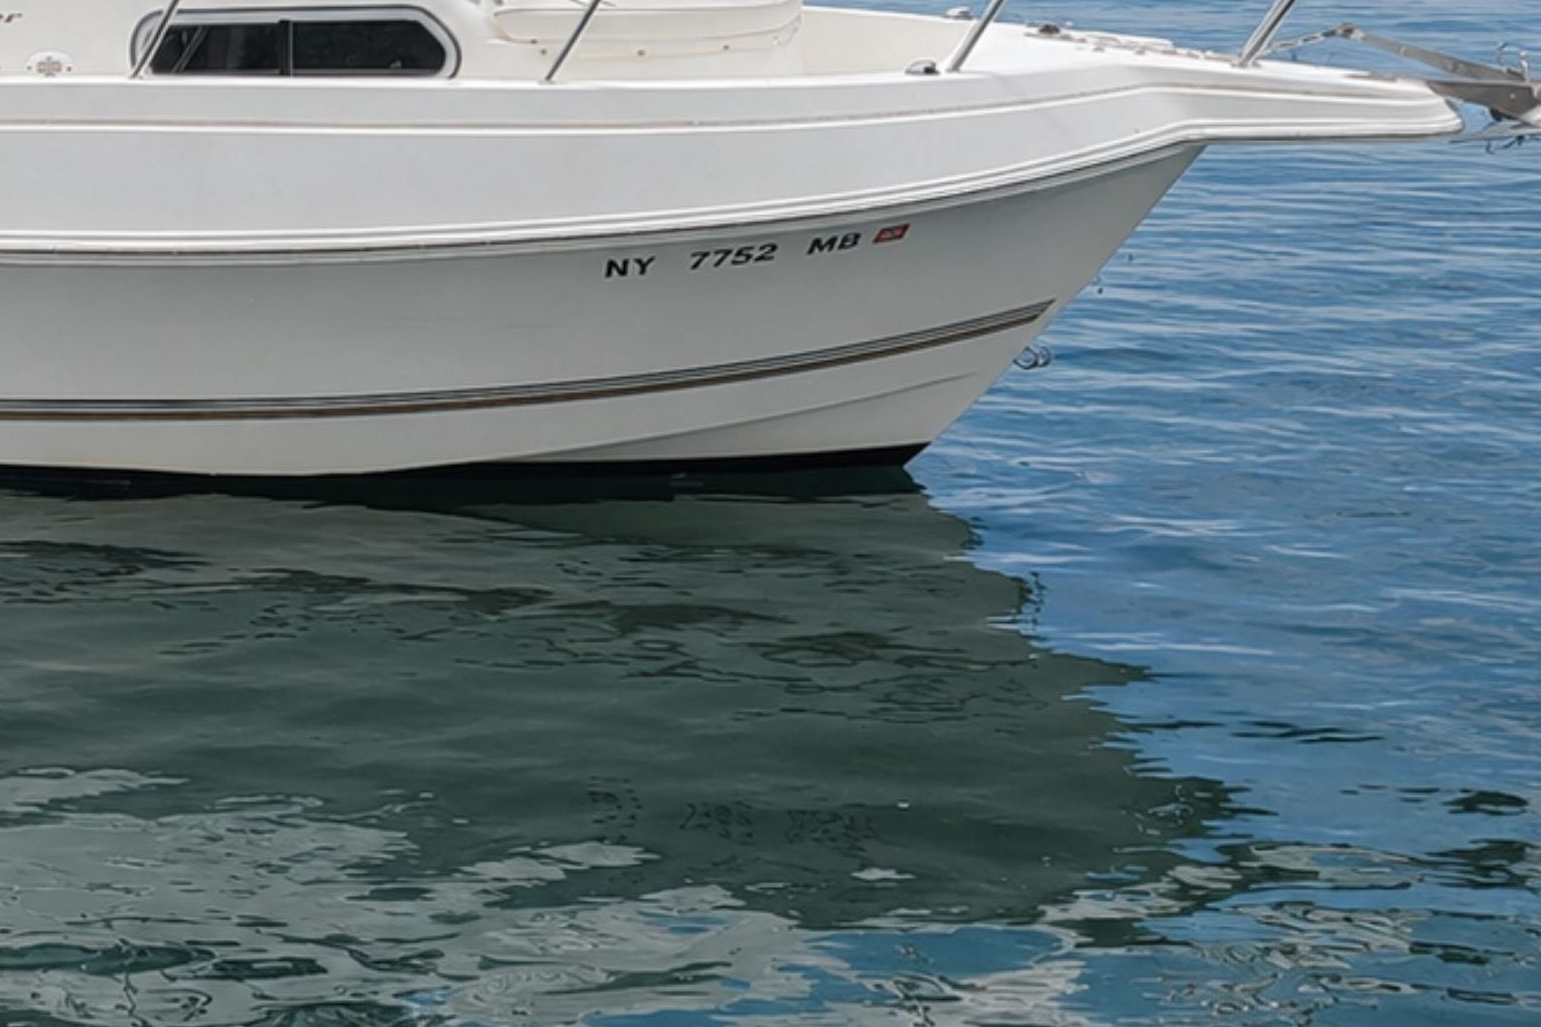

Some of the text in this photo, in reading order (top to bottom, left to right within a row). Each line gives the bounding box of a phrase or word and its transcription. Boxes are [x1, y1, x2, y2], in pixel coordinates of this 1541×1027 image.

[604, 255, 655, 278] NY
[689, 243, 778, 270] 7752
[807, 232, 860, 255] MB
